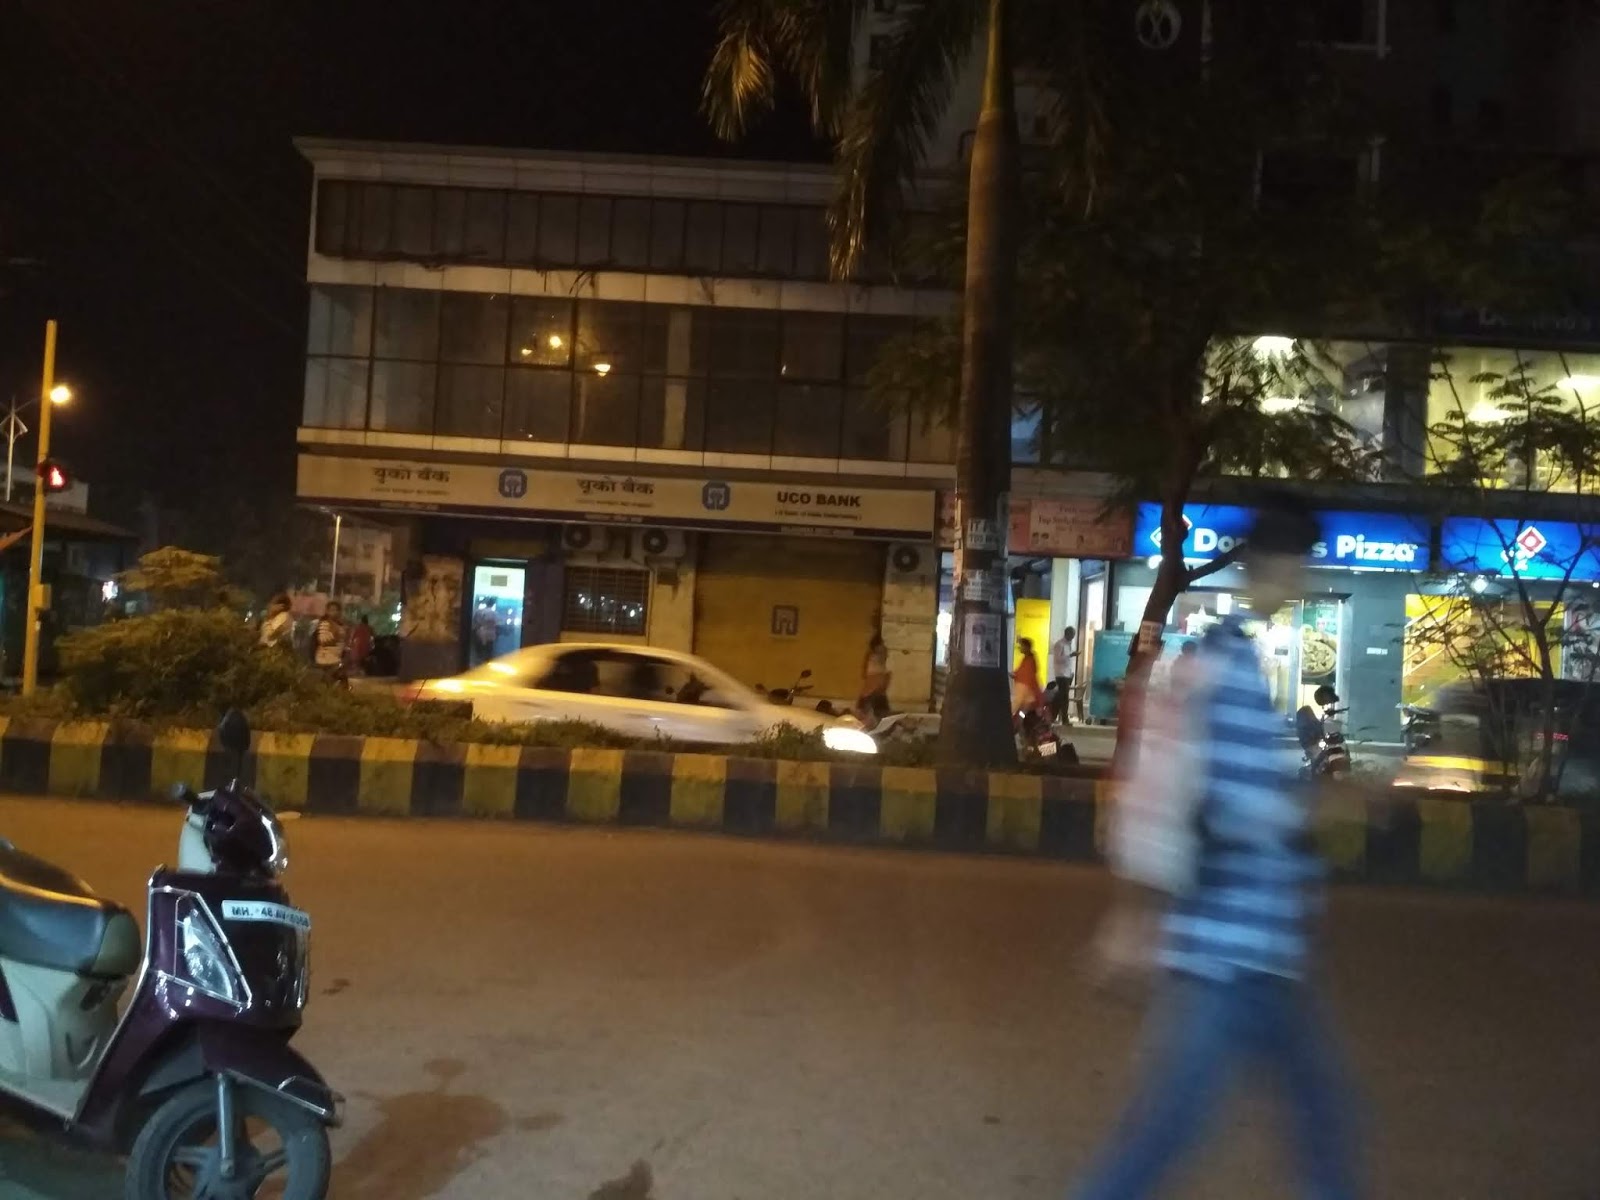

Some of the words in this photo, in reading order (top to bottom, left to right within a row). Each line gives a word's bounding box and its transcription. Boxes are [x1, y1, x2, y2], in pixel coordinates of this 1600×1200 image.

[776, 491, 811, 504] UCO
[816, 493, 861, 508] BANK
[1336, 533, 1415, 563] Pizza
